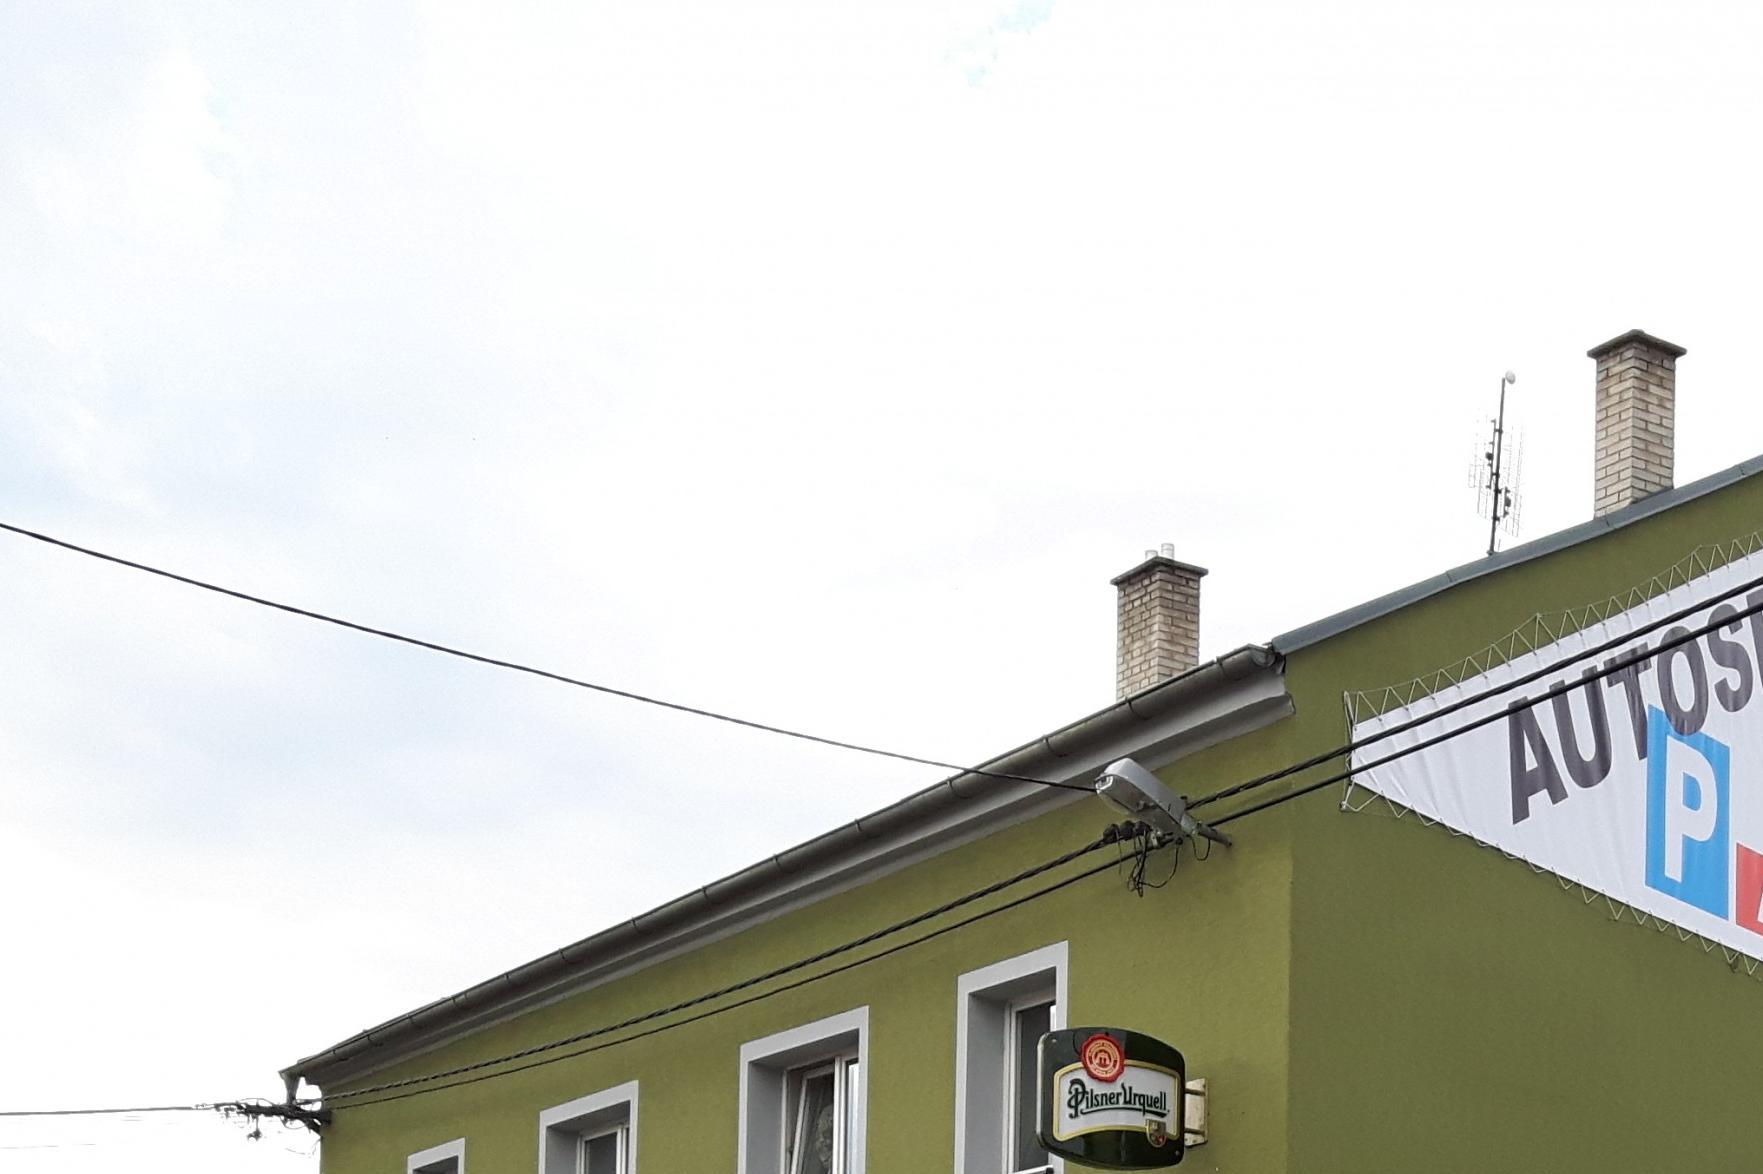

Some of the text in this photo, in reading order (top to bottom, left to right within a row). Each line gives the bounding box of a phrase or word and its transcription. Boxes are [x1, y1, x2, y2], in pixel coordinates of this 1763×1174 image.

[1665, 735, 1718, 882] P
[1067, 1078, 1167, 1119] Pilsner Urquell
